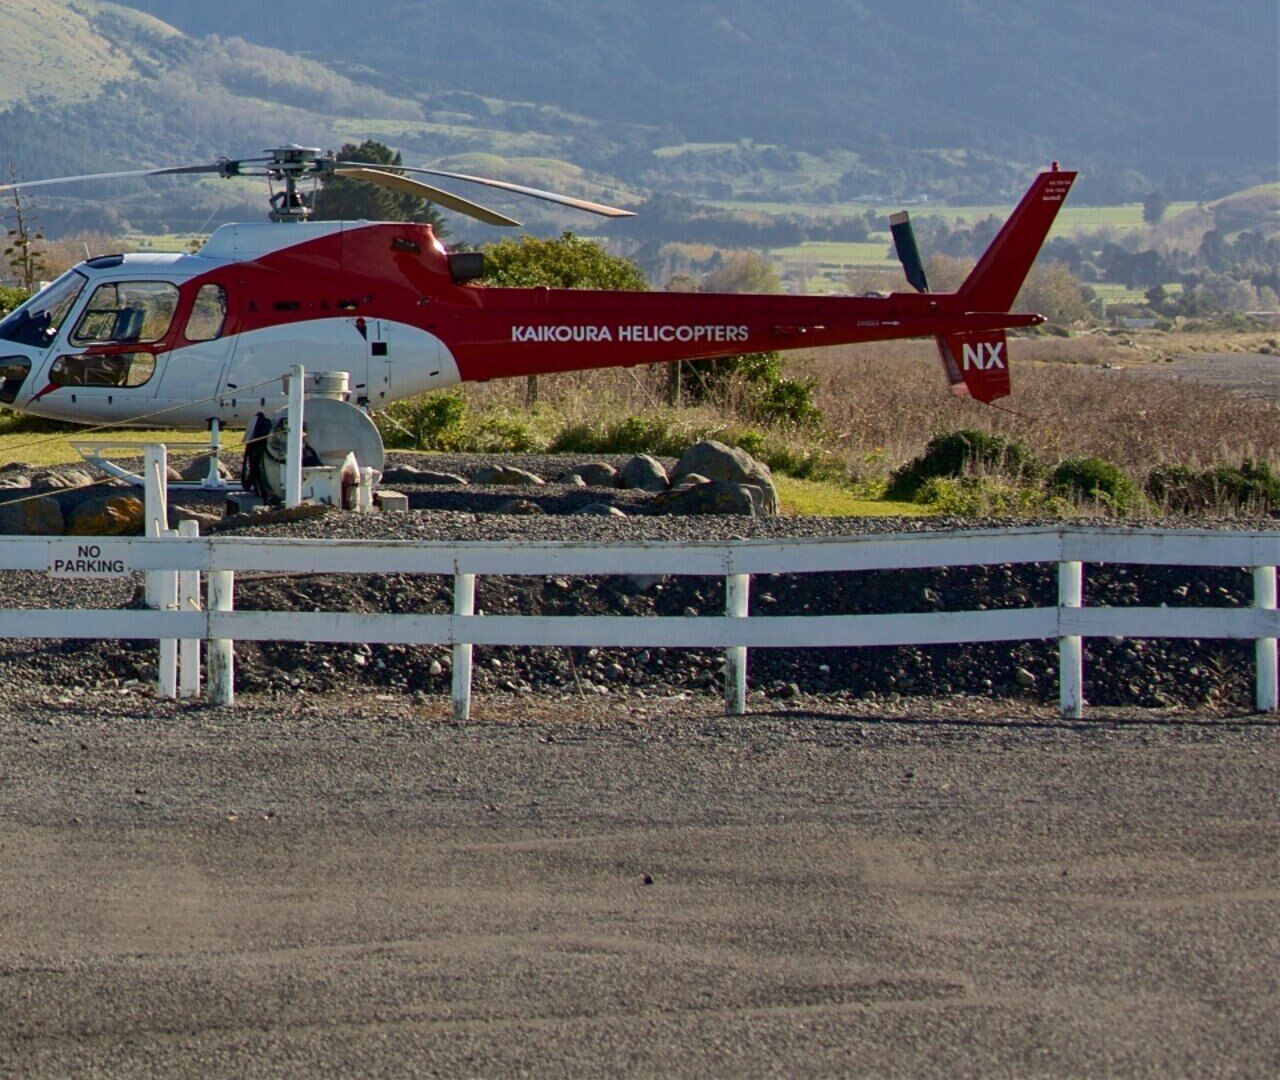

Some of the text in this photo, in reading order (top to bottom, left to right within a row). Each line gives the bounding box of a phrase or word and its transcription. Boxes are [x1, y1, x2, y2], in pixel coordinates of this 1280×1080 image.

[511, 325, 749, 342] KAIKOURA HELICOPTERS
[962, 341, 1005, 371] NX
[78, 545, 101, 558] NO
[54, 560, 125, 573] PARKING
